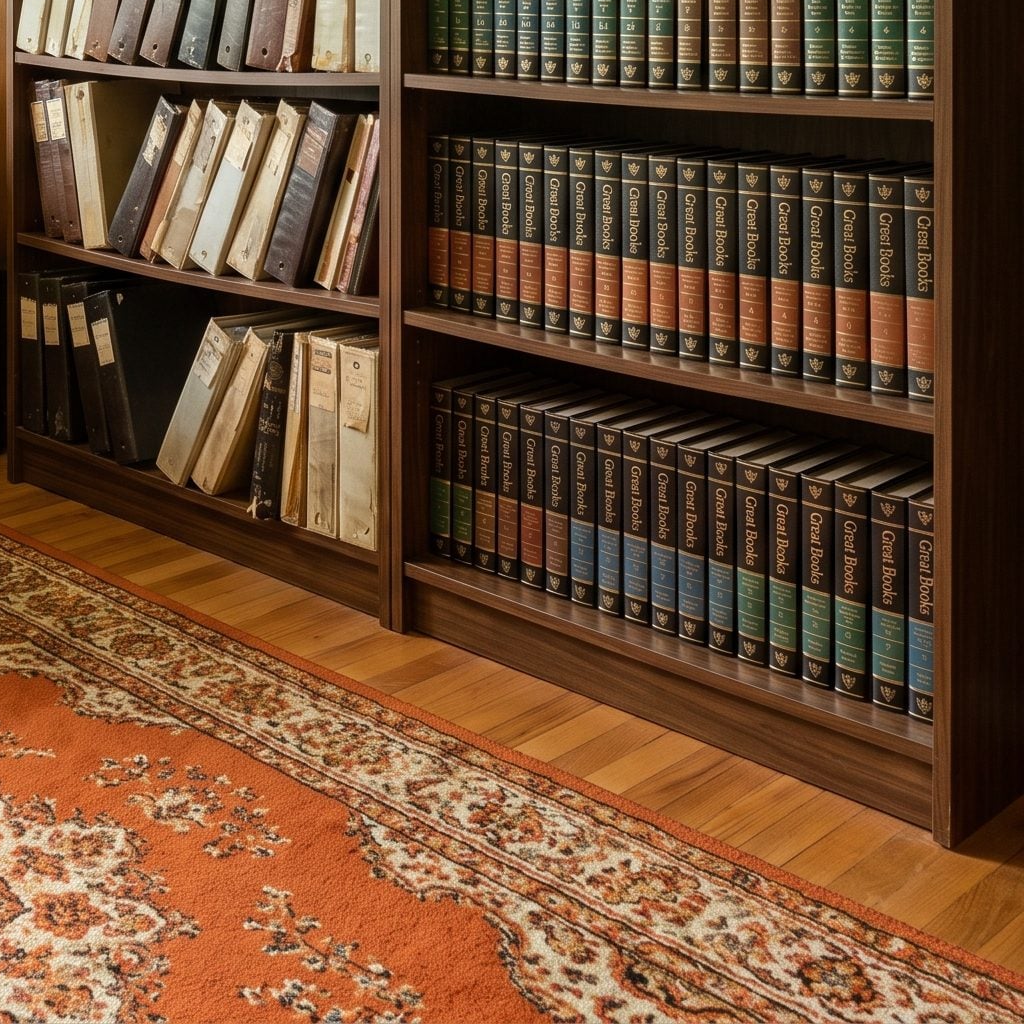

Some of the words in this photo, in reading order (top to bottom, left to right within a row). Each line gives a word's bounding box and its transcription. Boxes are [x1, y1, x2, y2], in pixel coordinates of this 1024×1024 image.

[686, 227, 697, 262] Books
[716, 230, 728, 266] Books
[779, 237, 792, 274] Books
[844, 245, 856, 282] Books
[880, 249, 893, 287] Books
[918, 252, 932, 292] Books
[686, 513, 697, 547] Books
[746, 530, 757, 565] Books
[811, 513, 822, 545] Great
[844, 521, 856, 553] Great
[882, 531, 895, 563] Great
[811, 547, 823, 584] Books
[844, 555, 857, 594] Books
[882, 565, 896, 604] Books
[921, 576, 933, 615] Books
